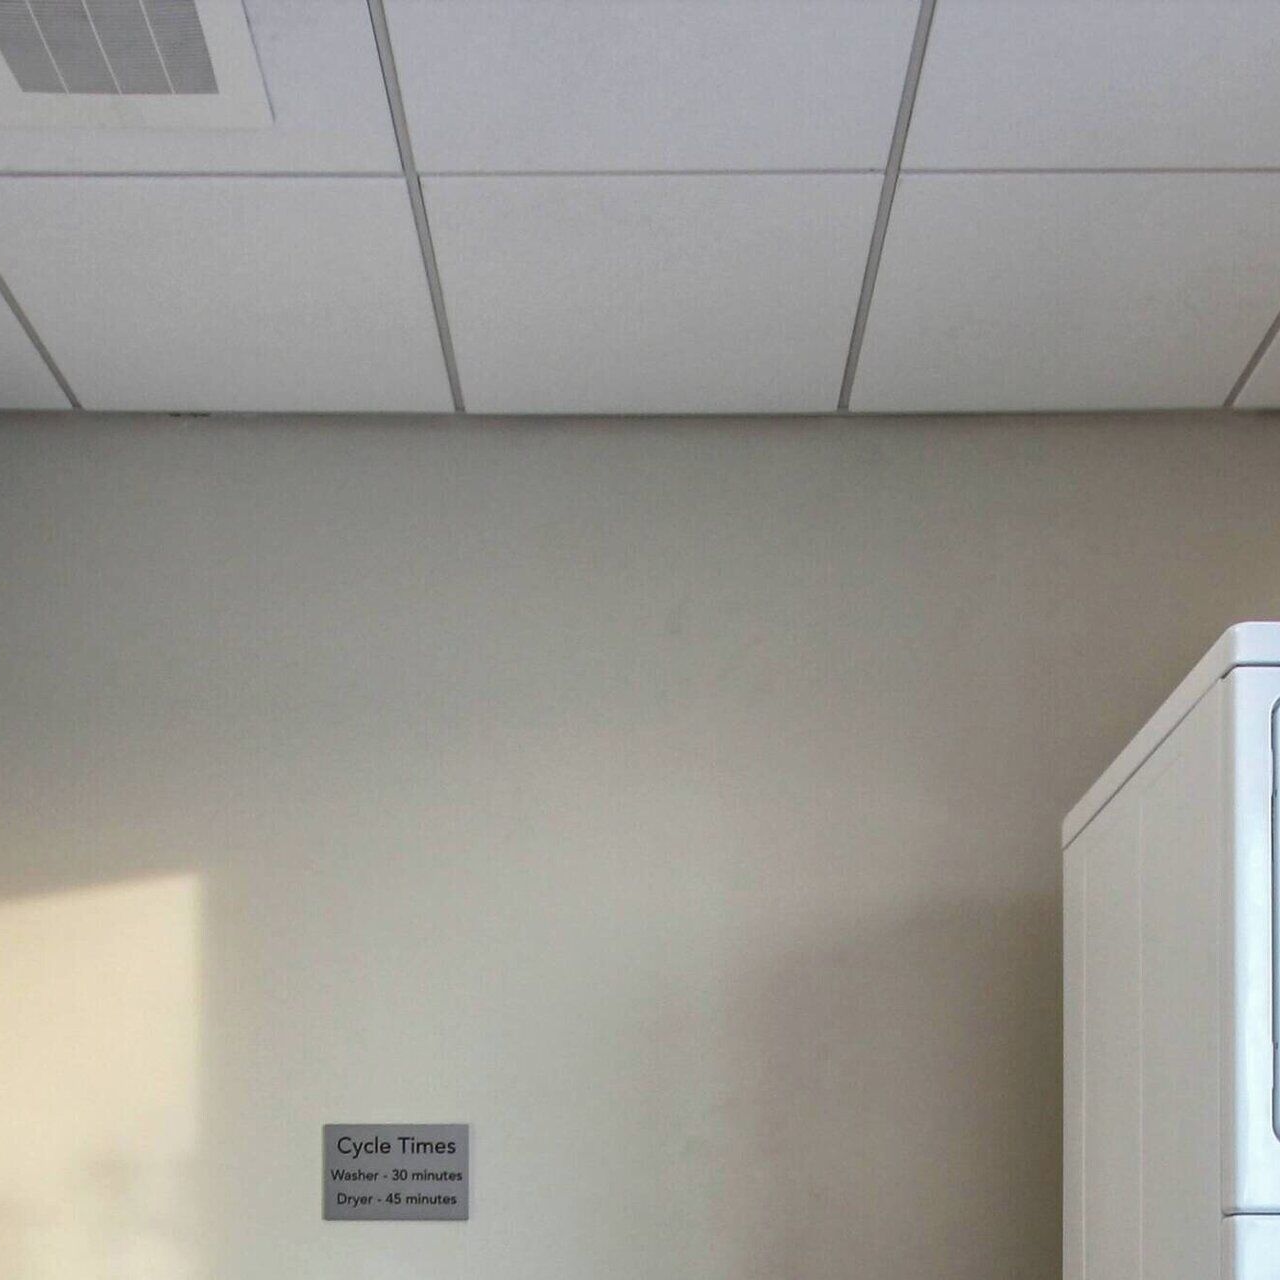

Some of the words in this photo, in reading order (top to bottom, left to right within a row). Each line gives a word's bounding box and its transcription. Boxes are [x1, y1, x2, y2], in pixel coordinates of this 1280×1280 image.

[337, 1136, 391, 1159] Cycle
[397, 1136, 457, 1154] Times
[330, 1169, 379, 1181] Washer
[392, 1169, 408, 1181] 30
[411, 1169, 463, 1181] minutes
[337, 1193, 373, 1208] Dryer
[385, 1193, 402, 1205] 45
[406, 1193, 457, 1205] minutes
